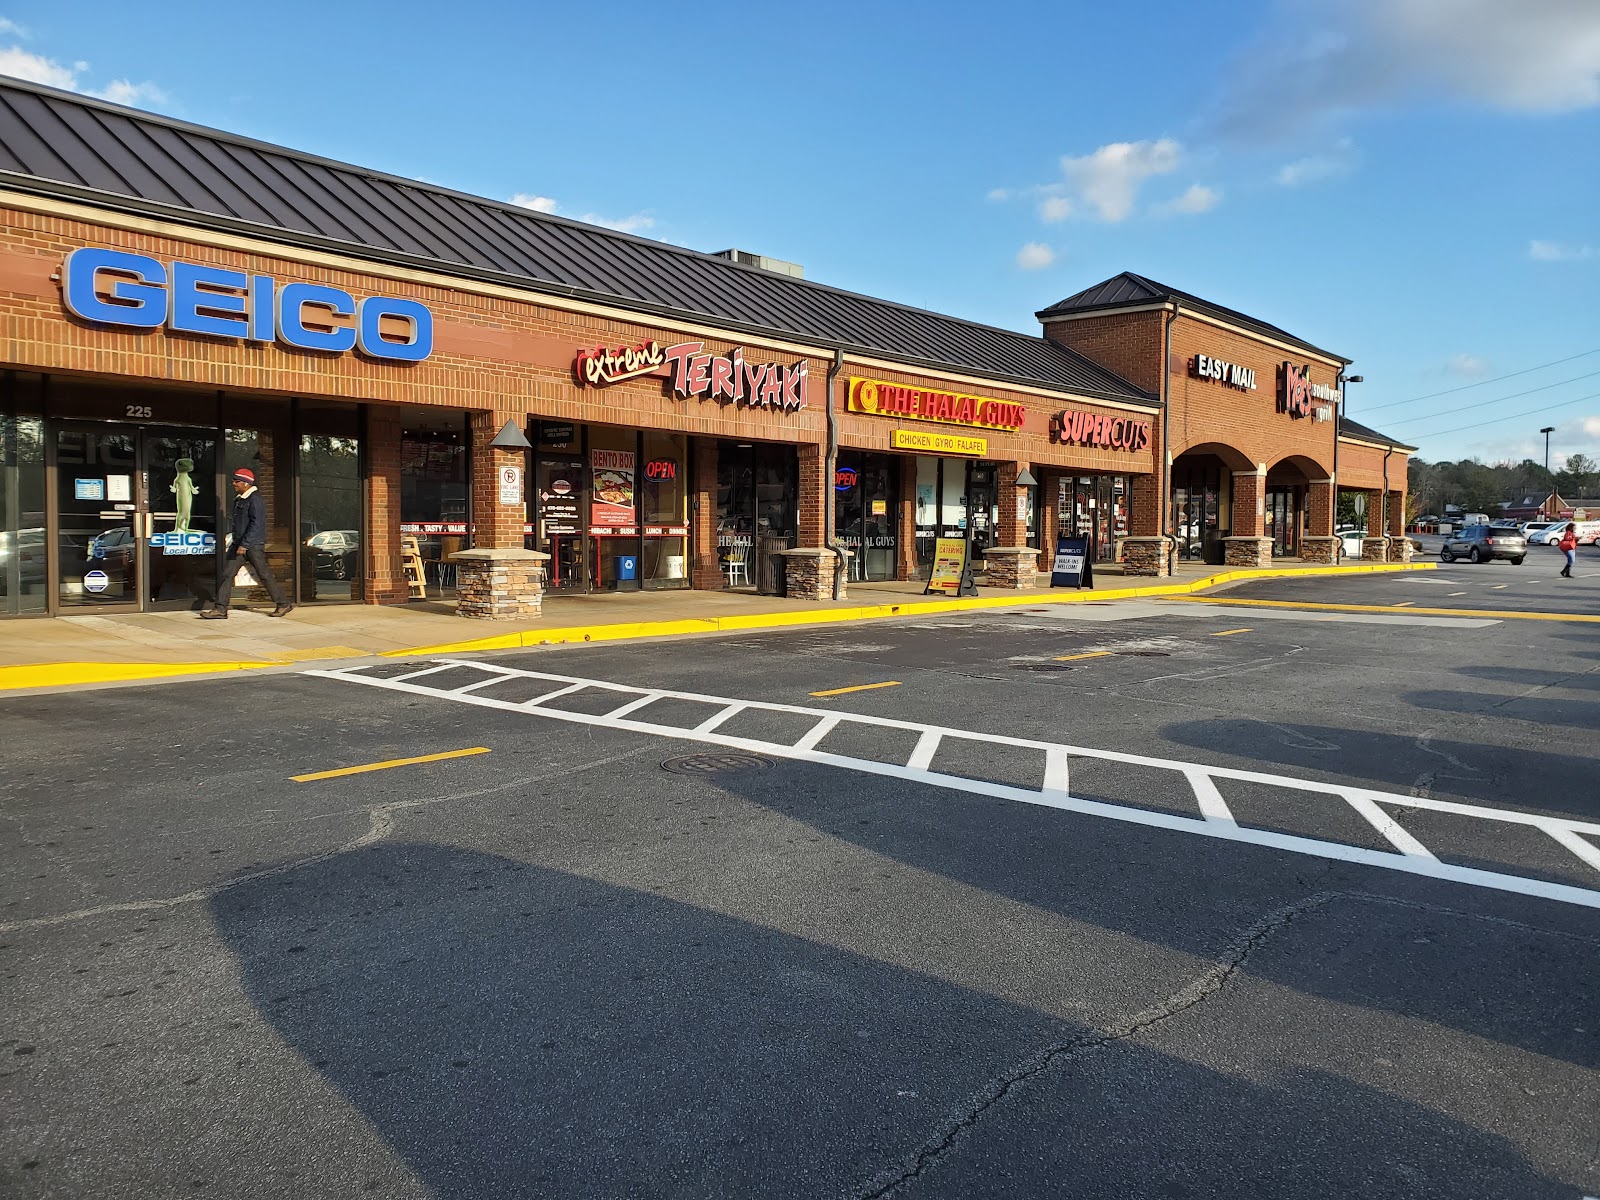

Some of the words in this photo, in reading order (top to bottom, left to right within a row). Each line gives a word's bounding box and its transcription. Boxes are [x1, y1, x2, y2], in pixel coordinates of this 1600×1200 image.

[63, 247, 433, 362] GEICO
[584, 340, 664, 384] extreme
[1198, 353, 1230, 382] EASY
[1231, 364, 1257, 390] MAIL
[126, 405, 152, 418] 225
[880, 385, 920, 413] THE
[925, 390, 982, 423] HALAL
[986, 401, 1026, 427] GUYS
[1060, 410, 1150, 449] SUPERCUTS
[899, 434, 931, 447] CHICKEN
[935, 438, 954, 449] GYRO
[957, 440, 985, 452] FALAFEL
[593, 450, 617, 468] BENTO
[619, 452, 634, 469] BOX
[645, 461, 676, 479] OPEN
[834, 473, 857, 486] OPEN
[425, 524, 442, 532] TASTY
[448, 524, 466, 532] VALUE
[591, 527, 612, 535] HIBACHI
[646, 527, 662, 535] LUNCH
[149, 533, 216, 546] GEICO
[875, 536, 895, 547] GUYS
[164, 546, 188, 554] Local
[939, 546, 963, 554] CATERING
